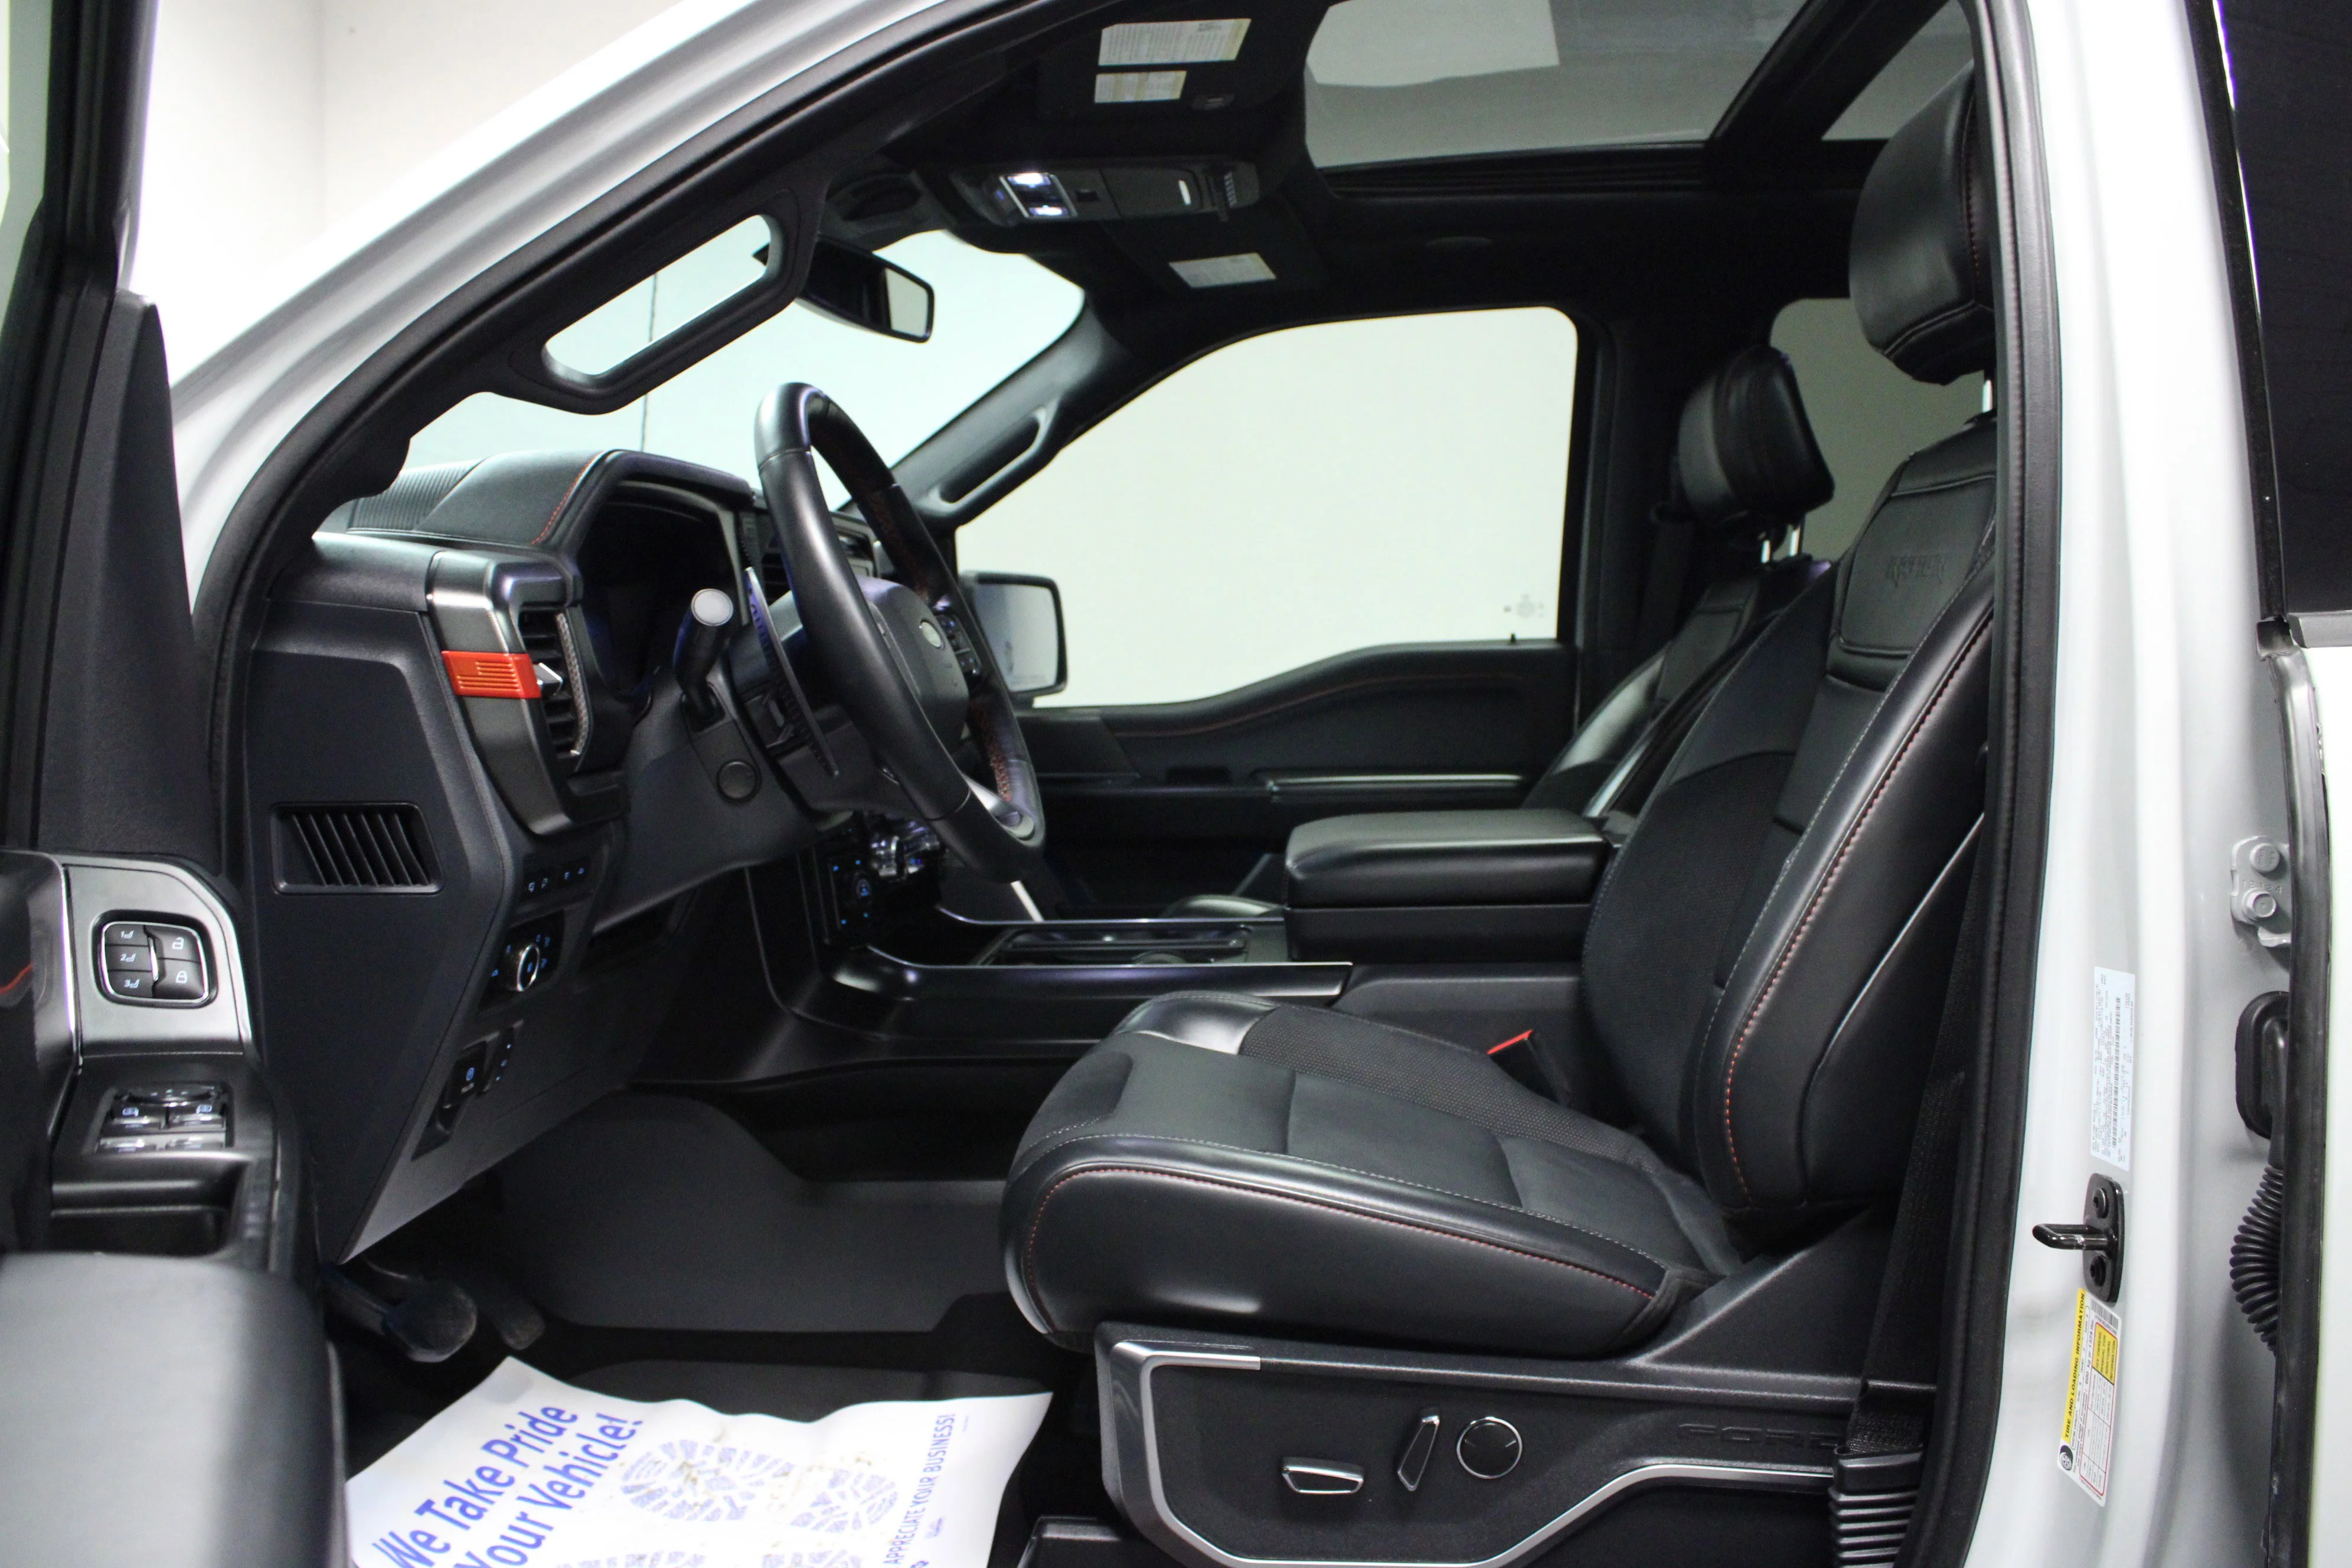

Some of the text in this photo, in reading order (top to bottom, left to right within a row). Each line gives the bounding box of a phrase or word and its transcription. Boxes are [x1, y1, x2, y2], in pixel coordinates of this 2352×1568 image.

[120, 953, 127, 962] 2
[124, 979, 130, 988] 3
[2073, 1292, 2086, 1355] INFORMATION
[2069, 1355, 2079, 1396] LOADING
[515, 1412, 643, 1510] Vehicle!
[922, 1413, 956, 1474] BUSINESS!
[372, 1406, 578, 1568] We Take Pride
[909, 1475, 939, 1509] YOUR
[882, 1507, 926, 1564] APPRECIATE
